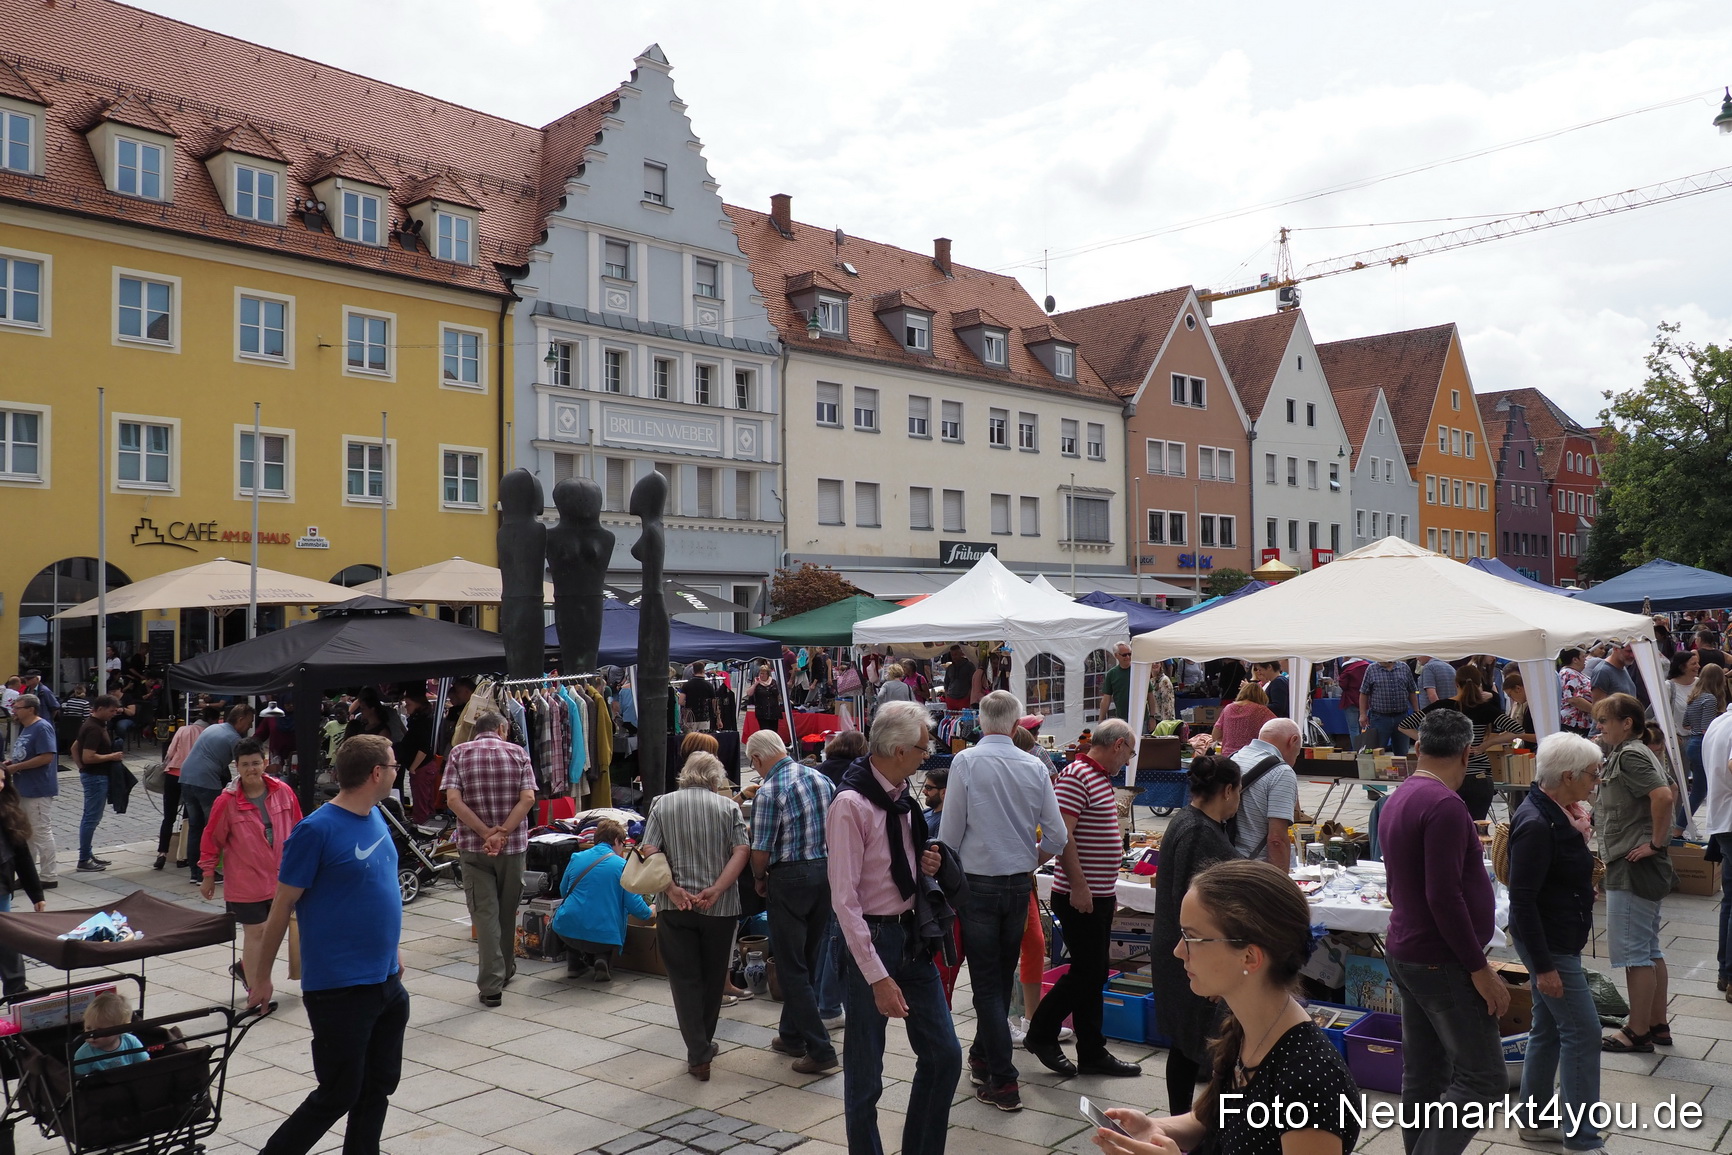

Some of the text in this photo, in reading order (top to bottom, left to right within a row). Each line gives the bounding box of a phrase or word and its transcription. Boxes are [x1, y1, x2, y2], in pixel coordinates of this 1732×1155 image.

[610, 417, 714, 442] BRILLEN WEBER
[169, 520, 291, 544] CAFÉ AM RTHAUS
